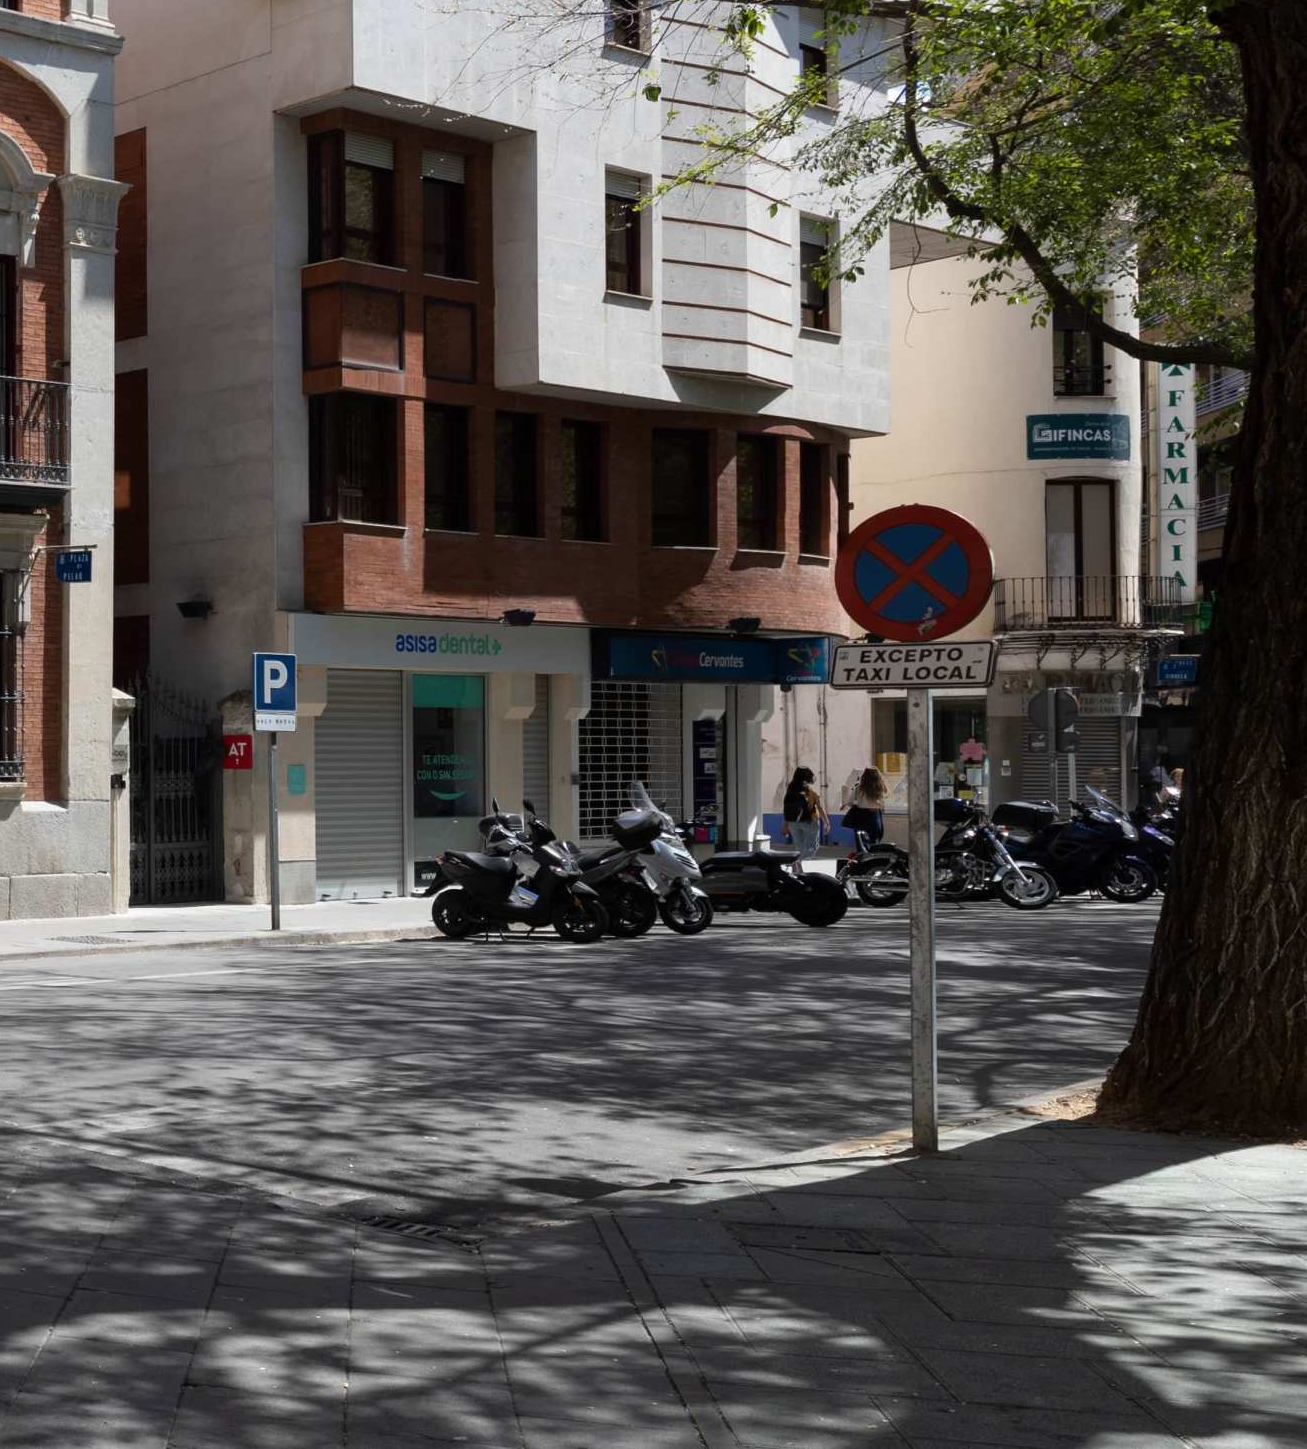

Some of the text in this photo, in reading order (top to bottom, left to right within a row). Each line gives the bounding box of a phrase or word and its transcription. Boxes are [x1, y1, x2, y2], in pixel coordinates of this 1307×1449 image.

[1163, 390, 1190, 587] FARMACIA
[395, 633, 490, 655] asisa dental
[699, 652, 744, 668] Cervantes
[860, 648, 964, 663] EXCEPTO
[843, 666, 977, 681] TAXI LOCAL
[263, 660, 288, 704] P
[228, 743, 247, 757] AT
